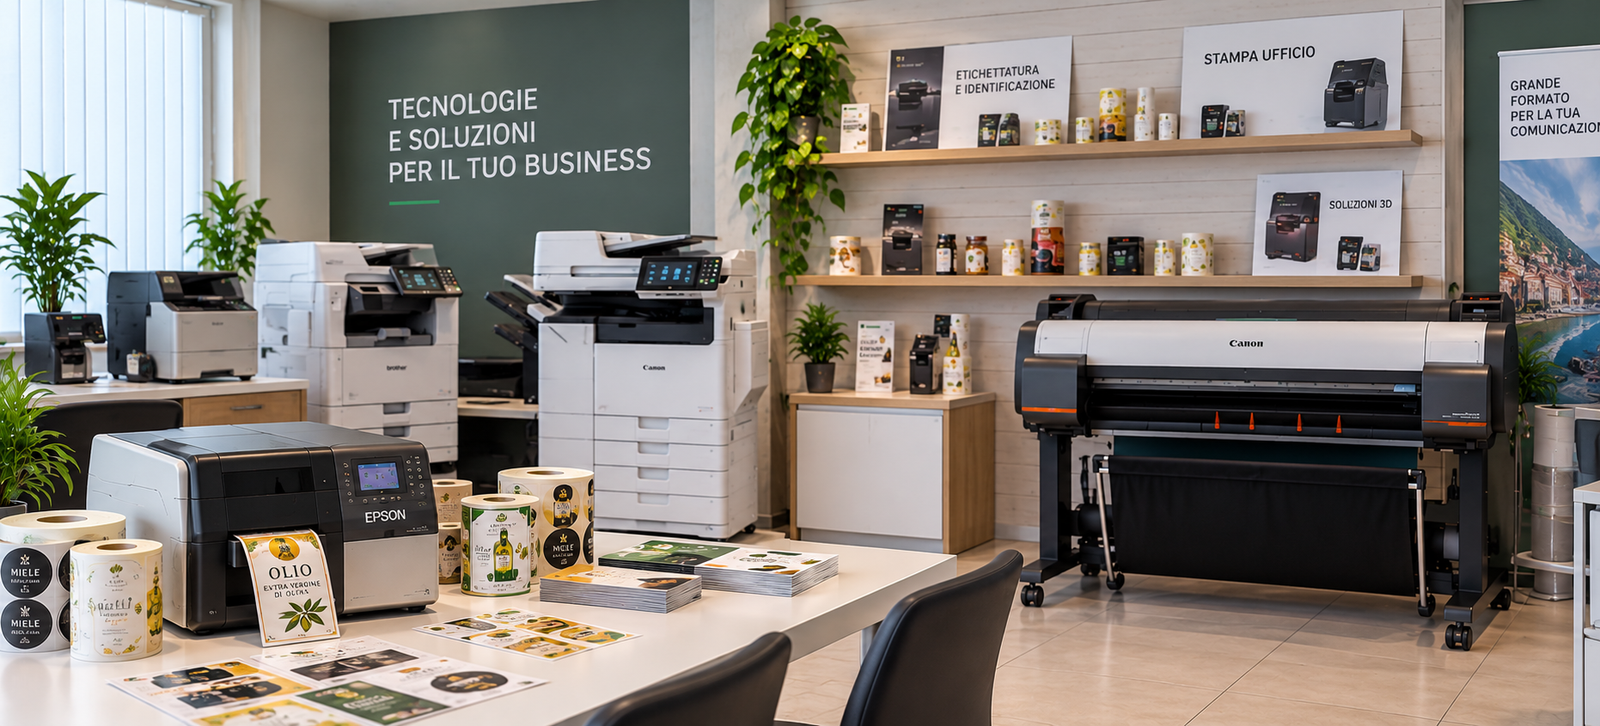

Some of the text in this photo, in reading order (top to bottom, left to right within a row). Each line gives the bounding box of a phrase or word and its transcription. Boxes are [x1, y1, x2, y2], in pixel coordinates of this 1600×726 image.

[1204, 45, 1316, 66] STAMPA UFFICIO
[955, 64, 1040, 81] ETICHETTATURA
[955, 78, 1056, 95] E IDENTIFICAZIONE
[1510, 77, 1561, 91] GRANDE
[388, 87, 538, 120] TECNOLOGIE
[1510, 92, 1570, 107] FORMATO
[1510, 107, 1581, 122] PER LA TUA
[389, 120, 536, 152] E SOLUZIONI
[389, 146, 652, 184] PER IL TUO BUSINESS
[1379, 199, 1393, 209] 3D
[1229, 339, 1264, 348] Canon
[364, 509, 406, 524] EPSON
[10, 568, 40, 577] MIELE
[268, 563, 312, 580] OLIO
[10, 619, 40, 628] MIELE
